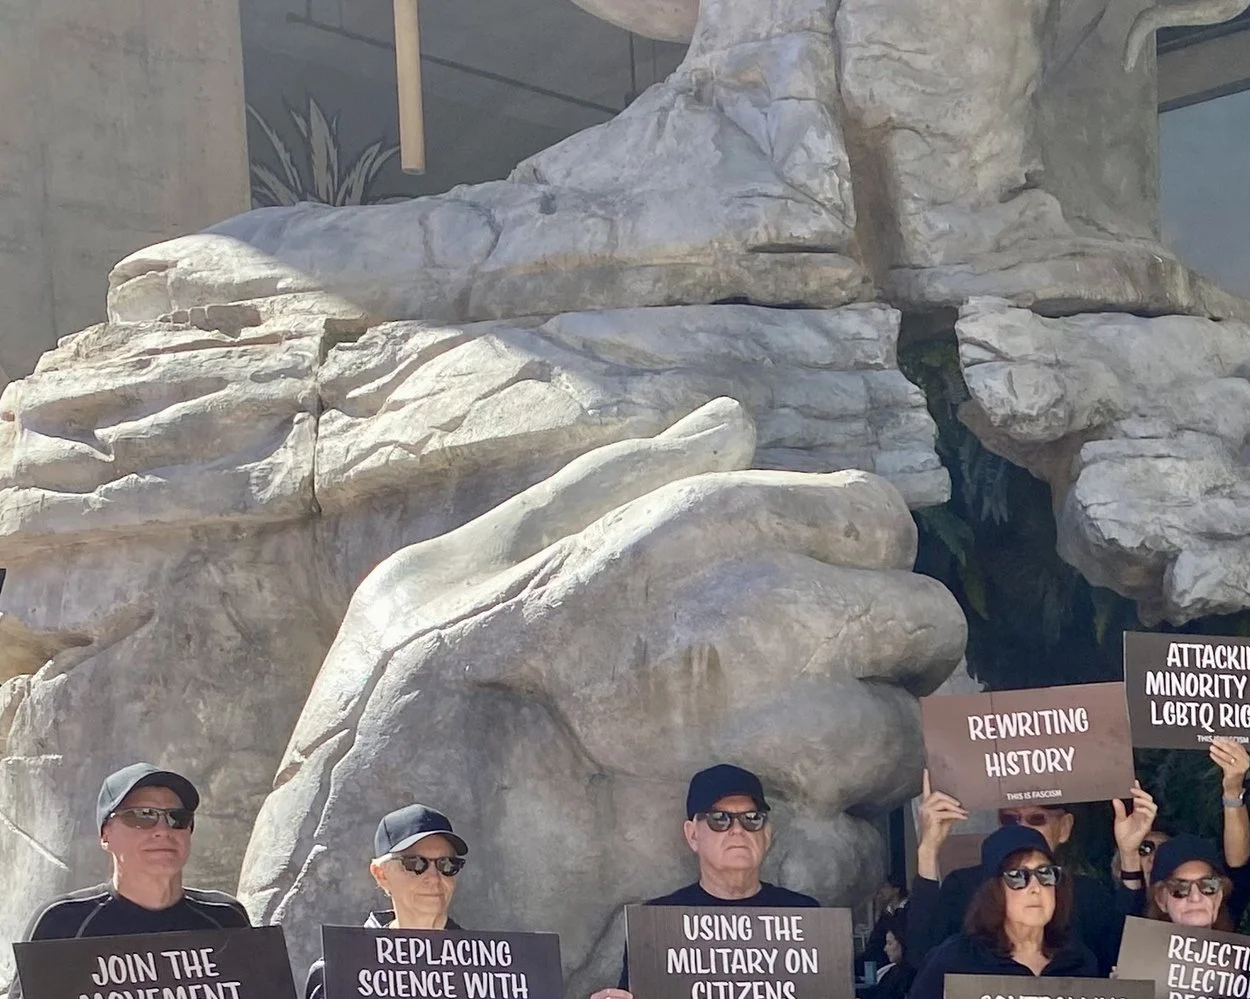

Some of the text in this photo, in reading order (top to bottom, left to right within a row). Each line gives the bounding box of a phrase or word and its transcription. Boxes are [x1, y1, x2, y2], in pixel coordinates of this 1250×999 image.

[1146, 671, 1247, 699] MINORITY
[967, 707, 1089, 741] REWRITING
[1151, 700, 1215, 733] LGBTQ
[985, 746, 1075, 777] HISTORY
[1031, 789, 1062, 798] FASCISM
[683, 914, 804, 941] USING THE
[91, 948, 220, 986] JOIN THE
[376, 937, 512, 967] REPLACING
[667, 947, 818, 974] MILITARY ON
[357, 969, 528, 999] SCIENCE WITH
